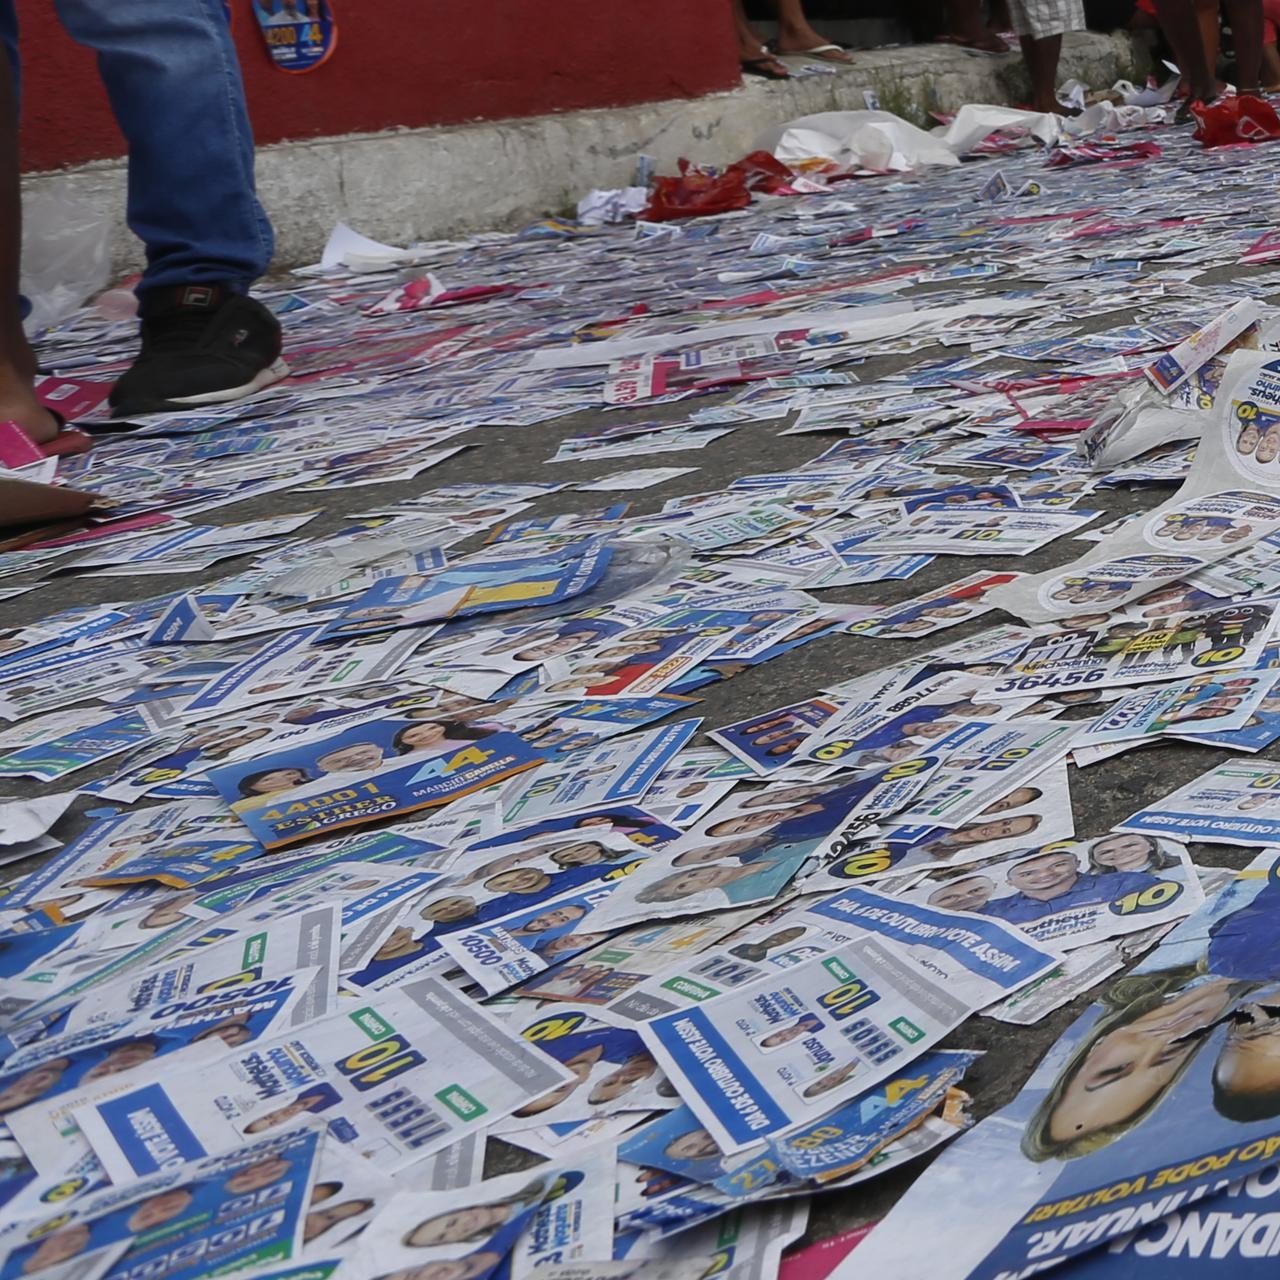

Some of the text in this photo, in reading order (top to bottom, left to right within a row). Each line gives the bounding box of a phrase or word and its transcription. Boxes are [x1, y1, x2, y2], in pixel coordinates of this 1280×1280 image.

[1239, 405, 1258, 418] 10
[1194, 648, 1246, 666] 10
[993, 670, 1107, 693] 36456
[405, 746, 496, 787] 44
[844, 848, 891, 876] 10
[1114, 882, 1181, 915] 10
[457, 933, 504, 968] 10500
[829, 898, 851, 913] DIA
[940, 927, 979, 953] VOTE
[977, 939, 1020, 973] ASSIM
[149, 973, 294, 1020] 10500
[823, 983, 870, 1017] 10
[345, 1040, 410, 1084] 10
[803, 1036, 838, 1068] Vanusa
[842, 1020, 902, 1065] 55405
[239, 1050, 288, 1101] Matheus.
[671, 1016, 771, 1133] DIA OUTUBRO VOTE ASSIM
[364, 1087, 453, 1150] 77555
[861, 1075, 930, 1122] 44
[127, 1106, 161, 1140] ASSIM
[1142, 1149, 1233, 1192] PODE
[1028, 1176, 1146, 1224] VOLTAR!
